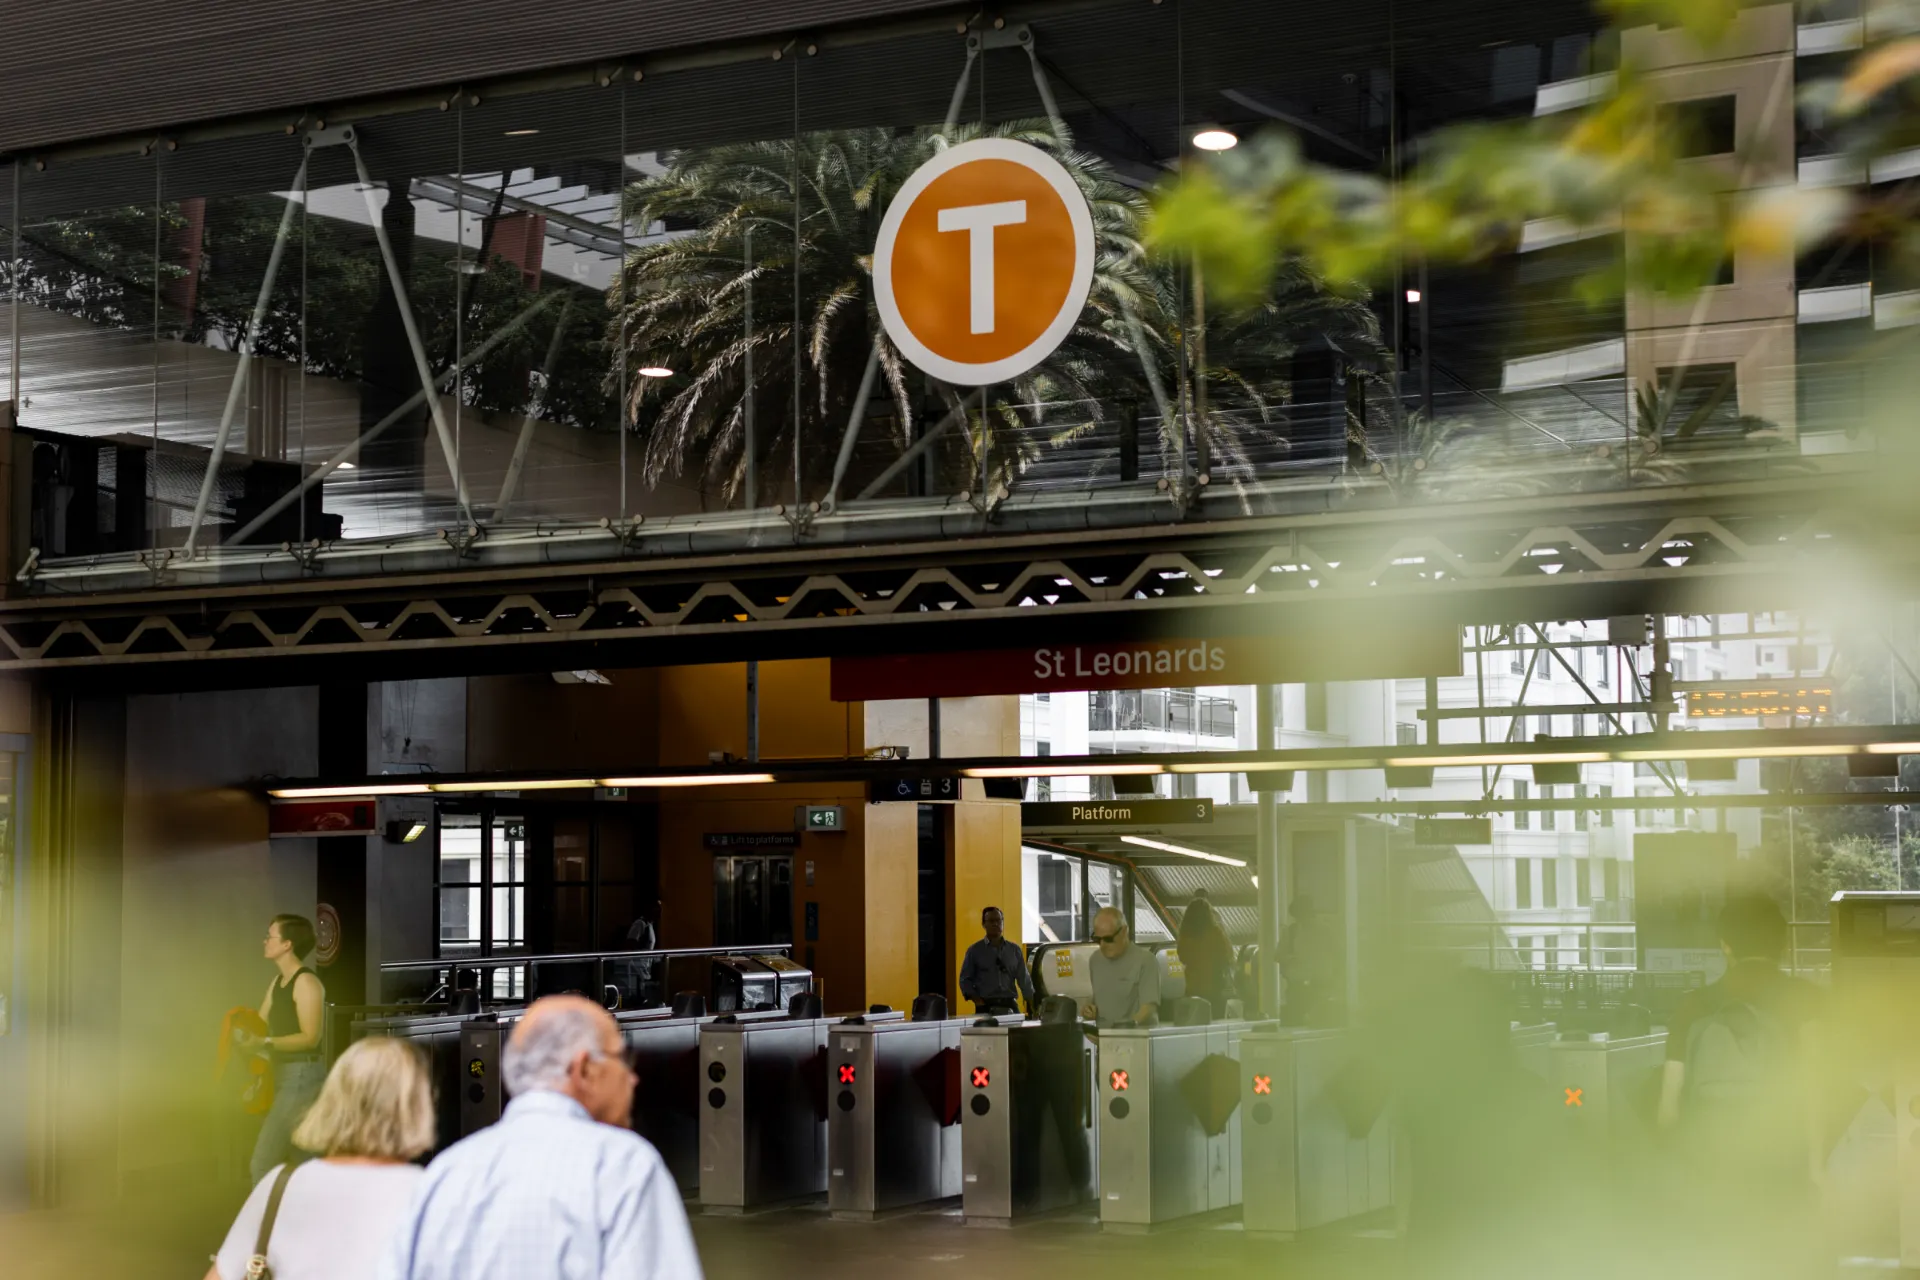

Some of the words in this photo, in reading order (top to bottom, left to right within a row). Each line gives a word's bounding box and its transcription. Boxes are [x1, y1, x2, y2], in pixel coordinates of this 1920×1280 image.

[937, 199, 1027, 335] T
[1034, 648, 1066, 679] St
[1075, 641, 1225, 677] Leonards
[941, 778, 951, 793] 3
[1072, 806, 1131, 820] Platform
[1196, 804, 1206, 818] 3
[731, 836, 745, 845] Lift
[746, 836, 755, 844] to
[756, 835, 794, 846] platforms
